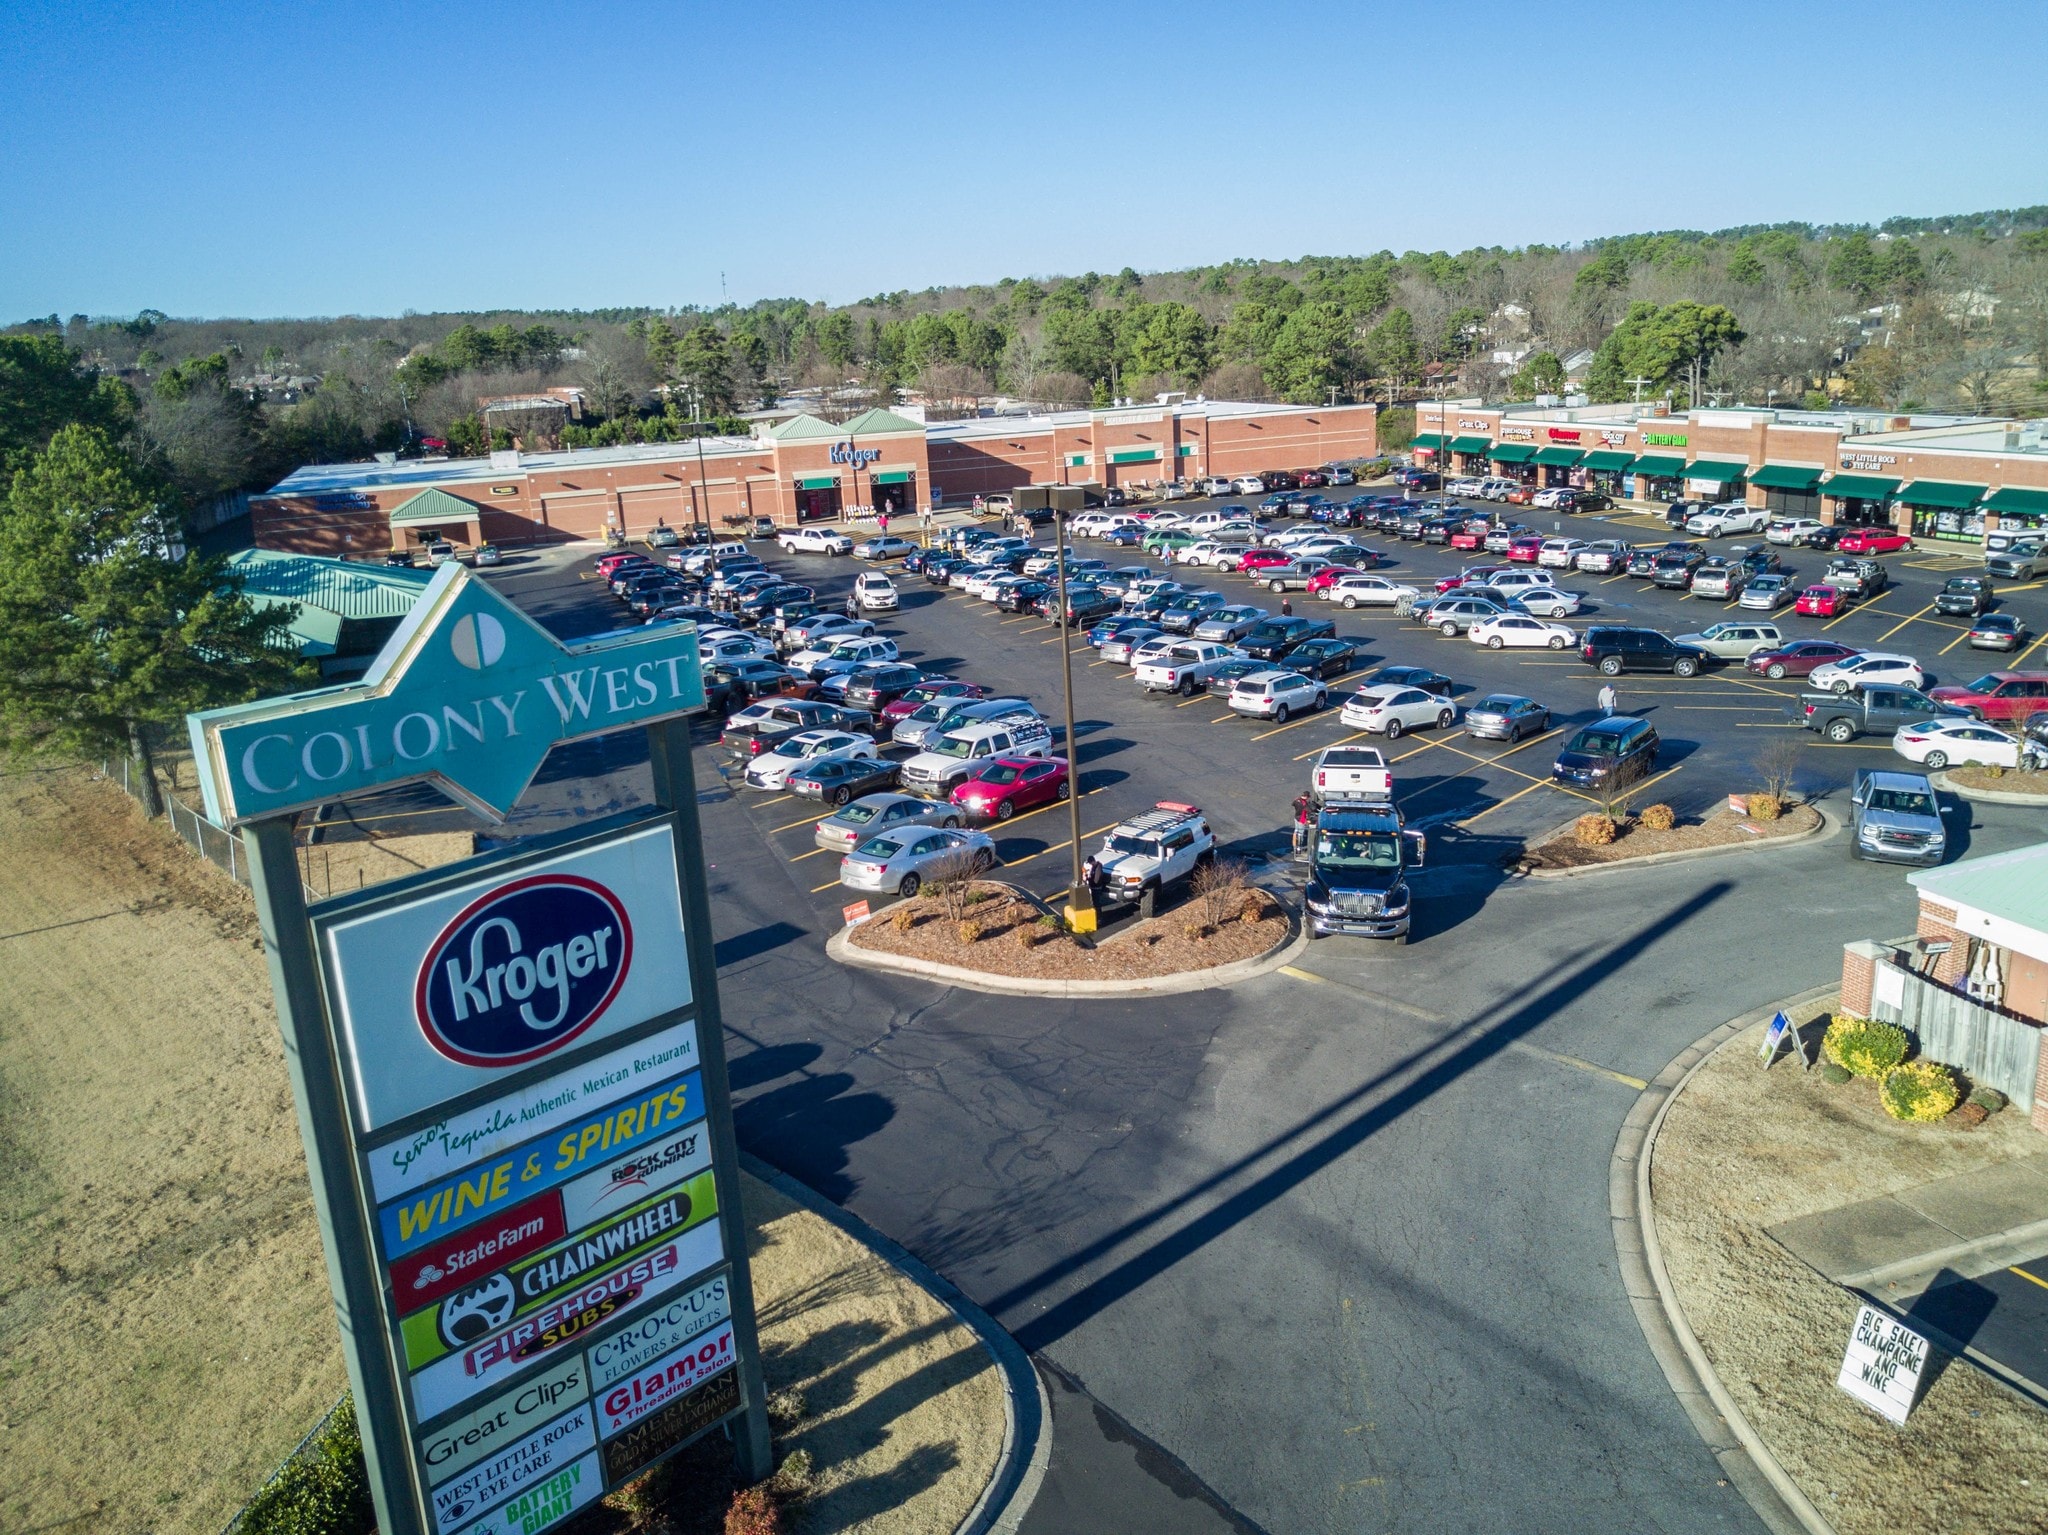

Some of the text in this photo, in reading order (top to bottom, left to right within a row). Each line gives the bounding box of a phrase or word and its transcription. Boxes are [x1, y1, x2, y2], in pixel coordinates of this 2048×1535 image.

[1458, 419, 1490, 430] Great Clips
[1548, 428, 1580, 440] Glamor
[1647, 433, 1672, 446] BATTERY
[829, 441, 879, 470] Kroger
[1853, 461, 1882, 471] EYE CARE
[1856, 454, 1878, 463] LITTLE
[1878, 456, 1896, 464] ROCK
[241, 654, 690, 795] COLONY WEST
[446, 916, 612, 1030] Kroger
[439, 1040, 691, 1158] Tequila Authentic Mexican Restaurant
[399, 1083, 688, 1242] WINE & SPIRITS
[612, 1151, 660, 1183] ROCK
[663, 1133, 698, 1157] CITY
[638, 1146, 696, 1179] RUNNING
[521, 1197, 684, 1297] CHAINWHEEL
[473, 1249, 675, 1379] FIREHOUSE
[542, 1299, 617, 1349] SUBS
[1863, 1311, 1883, 1333] BIG
[604, 1307, 721, 1381] FLOWERS & GIFTS
[1856, 1326, 1923, 1374] CHAMPAGNE
[1874, 1355, 1898, 1379] AND
[604, 1331, 732, 1416] Glamor
[612, 1354, 731, 1429] A Threading Salon
[1861, 1362, 1890, 1393] WINE
[425, 1371, 580, 1466] Great Clips
[610, 1371, 734, 1457] AMERICAN
[611, 1444, 639, 1470] GOLD
[651, 1417, 683, 1446] SILVER
[685, 1384, 737, 1424] EXCHANGE
[436, 1413, 586, 1510] WEST LITTLE ROCK
[478, 1450, 553, 1503] EYE CARE
[505, 1463, 582, 1525] BATTERY
[522, 1490, 573, 1535] GIANT
